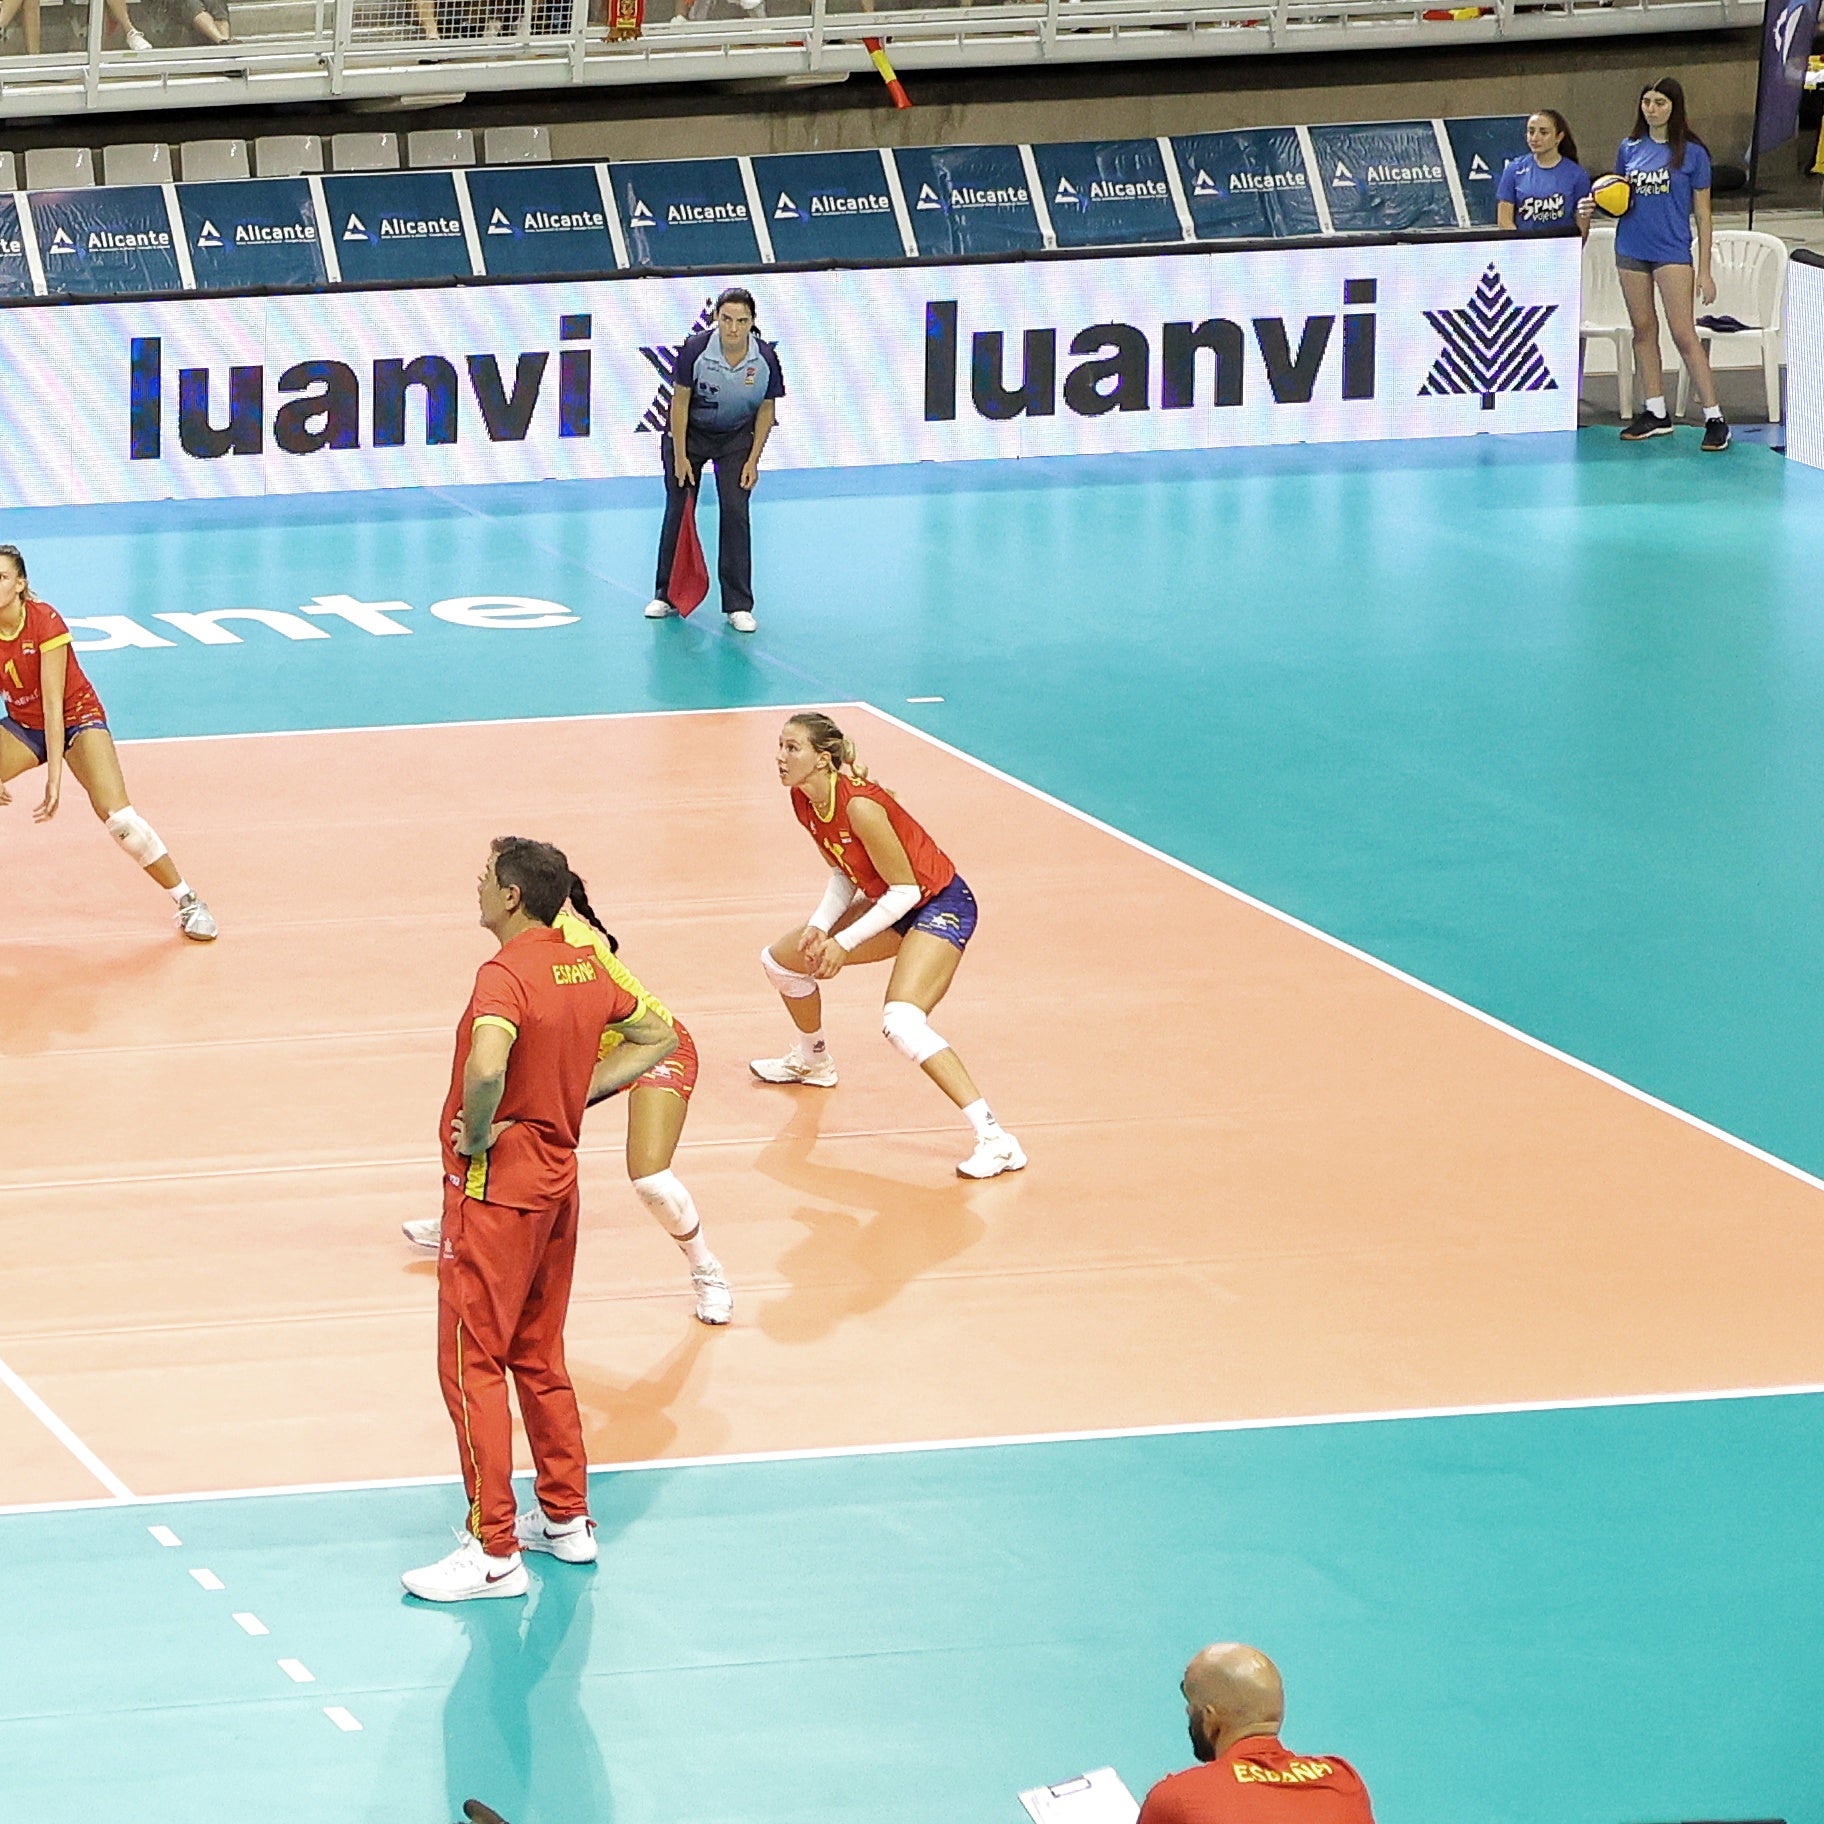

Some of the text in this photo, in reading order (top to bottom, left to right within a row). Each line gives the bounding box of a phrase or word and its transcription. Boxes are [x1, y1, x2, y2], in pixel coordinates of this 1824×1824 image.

[1228, 171, 1306, 189] Alicante
[1366, 162, 1443, 181] Alicante
[950, 185, 1029, 206] Alicante
[1089, 178, 1167, 198] Alicante
[667, 200, 748, 221] Alicante
[810, 192, 890, 213] Alicante
[380, 216, 461, 236] Alicante
[524, 208, 605, 229] Alicante
[88, 228, 170, 249] Alicante
[235, 221, 316, 241] Alicante
[924, 278, 1377, 422] luanvi
[128, 312, 592, 460] luanvi
[4, 658, 23, 689] 1
[551, 957, 596, 985] ESPAÑA
[1232, 1759, 1334, 1784] ESPAÑA
